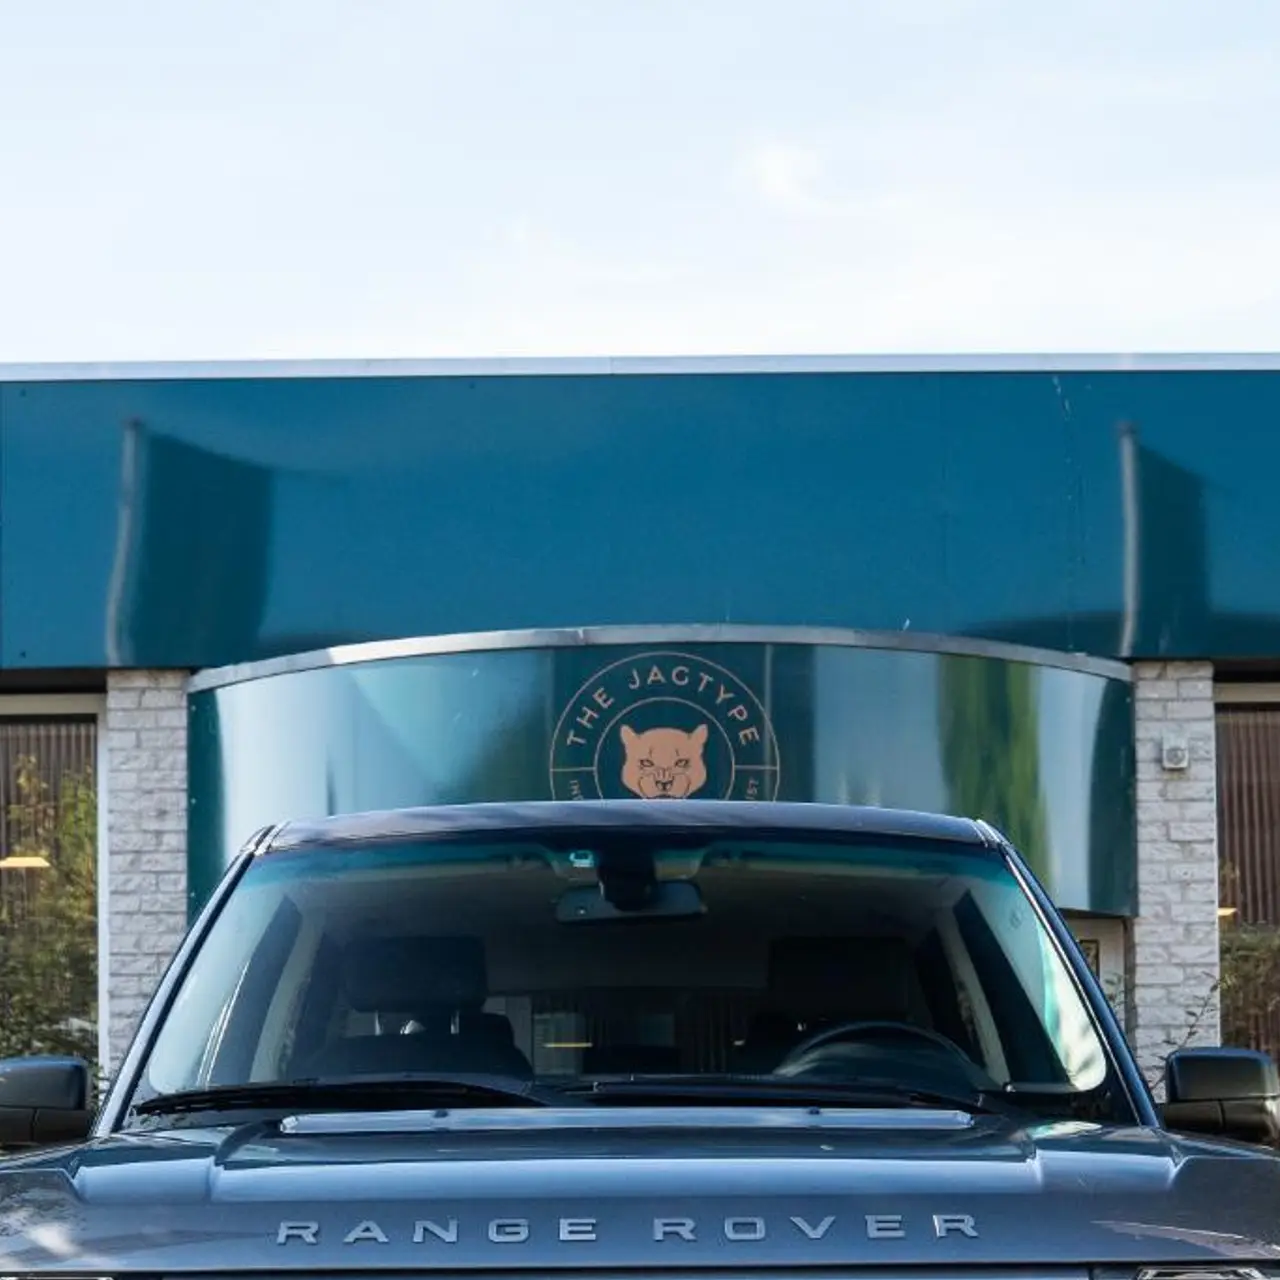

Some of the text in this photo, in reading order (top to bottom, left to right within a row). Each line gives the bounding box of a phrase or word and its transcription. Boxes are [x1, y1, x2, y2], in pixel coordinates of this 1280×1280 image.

[567, 665, 760, 746] THE JAGTYPE
[276, 1214, 980, 1244] RANGE ROVER
